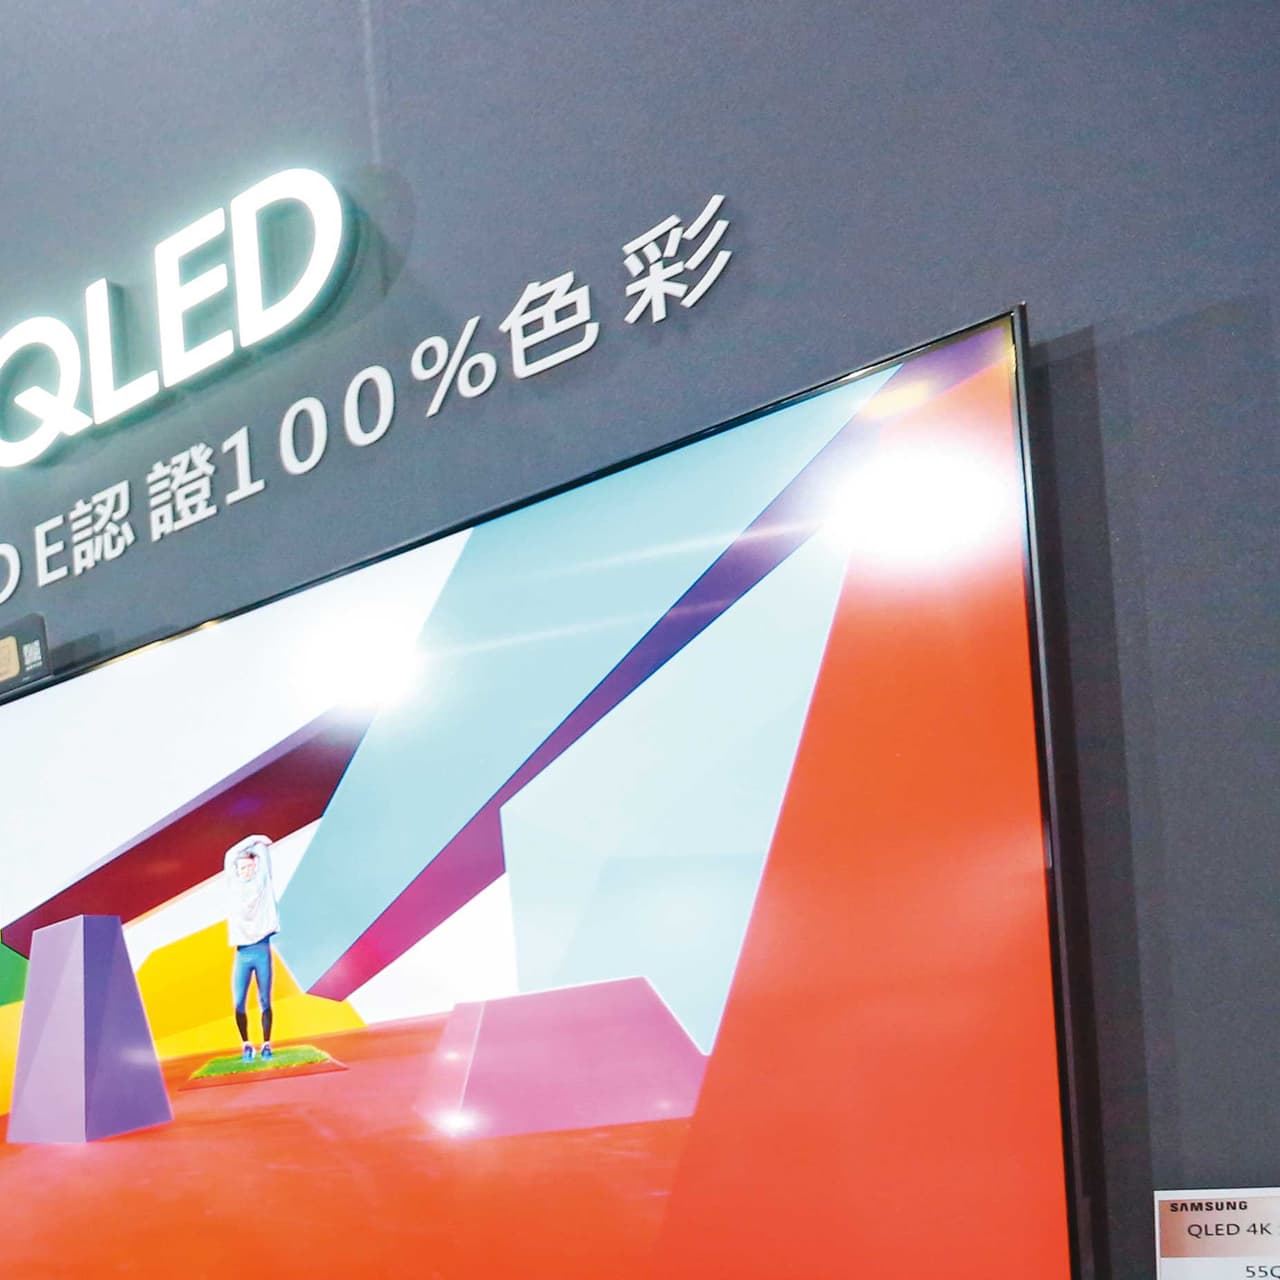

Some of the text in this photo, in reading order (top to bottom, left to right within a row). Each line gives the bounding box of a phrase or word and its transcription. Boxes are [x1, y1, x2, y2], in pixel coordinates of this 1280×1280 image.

[1170, 1201, 1248, 1212] SAMSUNG
[1187, 1222, 1272, 1239] QLED 4K
